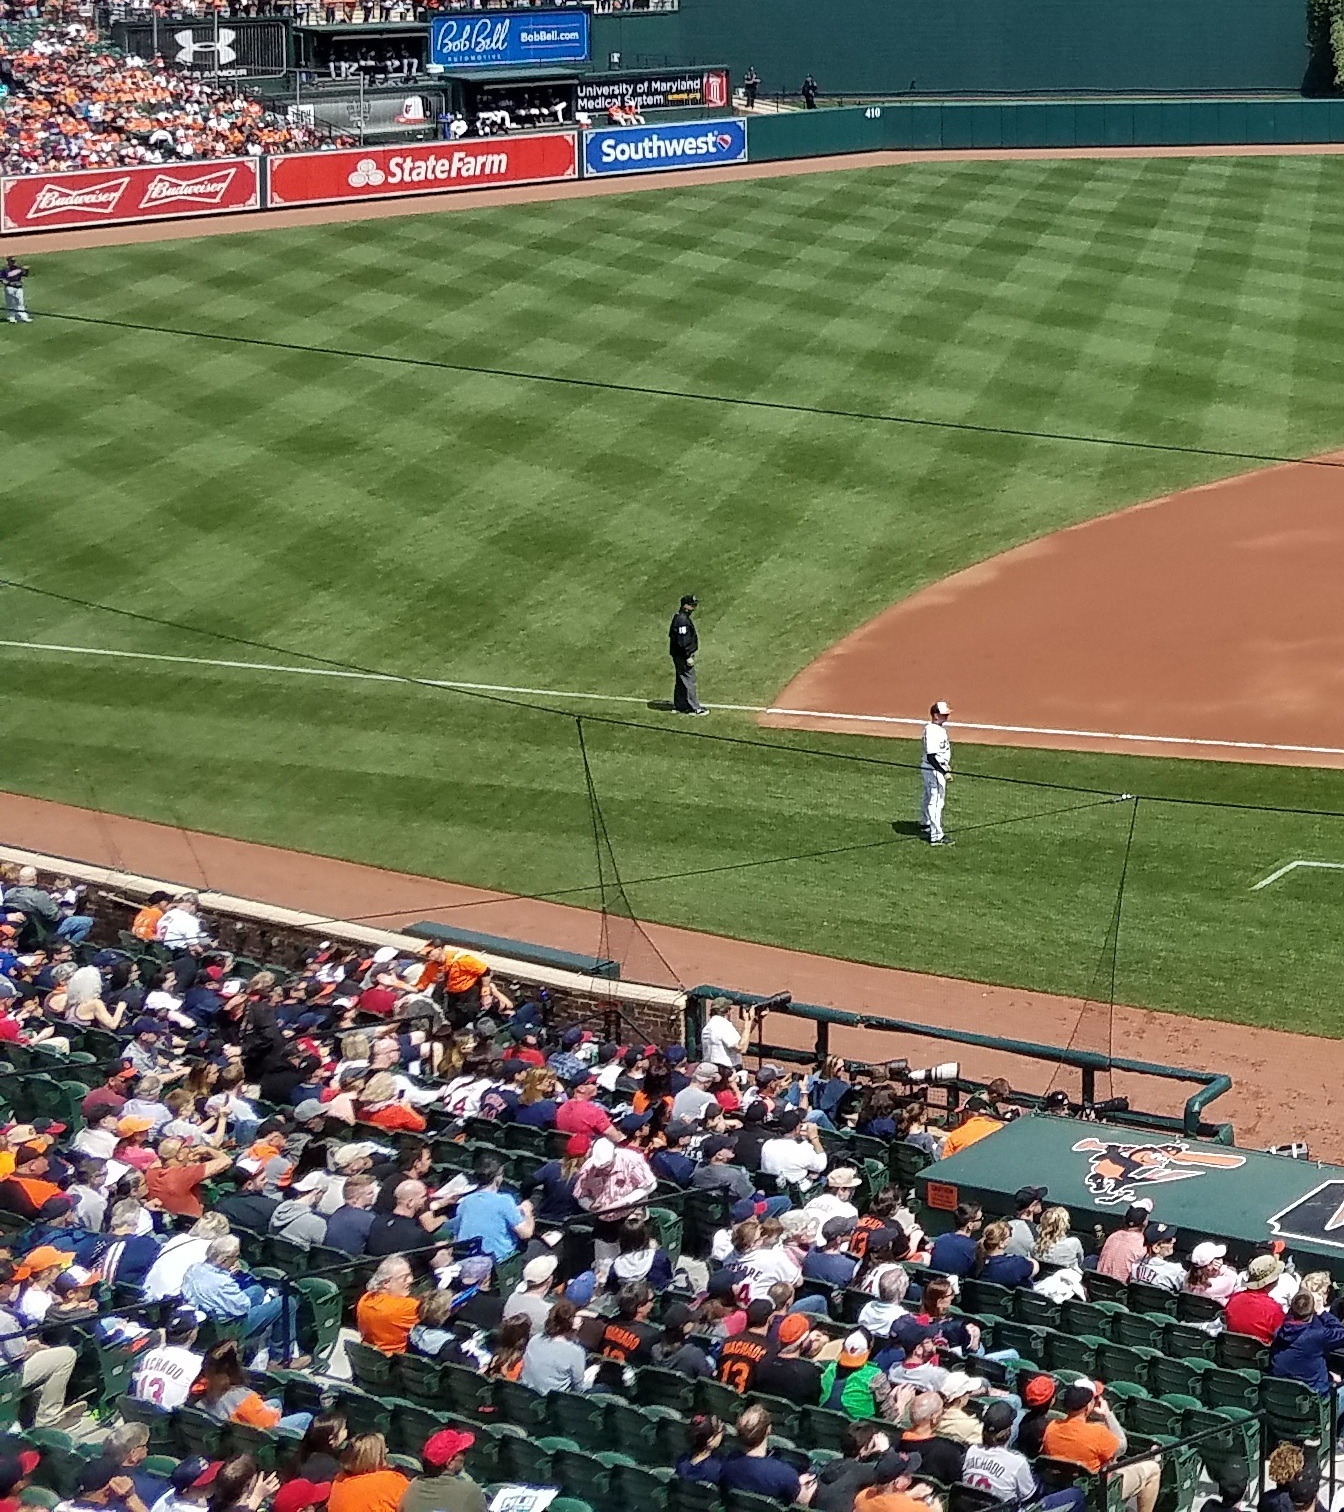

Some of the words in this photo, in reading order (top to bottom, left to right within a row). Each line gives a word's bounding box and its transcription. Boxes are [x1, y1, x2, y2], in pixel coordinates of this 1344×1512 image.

[437, 20, 471, 54] Bob
[472, 19, 511, 53] Bell
[521, 30, 579, 42] BobBell.com
[577, 80, 634, 97] University
[637, 80, 651, 93] of
[652, 78, 701, 95] Maryland
[623, 94, 664, 109] System
[865, 107, 881, 119] 410
[602, 132, 717, 163] Southwest
[152, 177, 228, 198] Budweiser
[39, 189, 120, 208] Budweiser
[720, 1360, 750, 1394] 13
